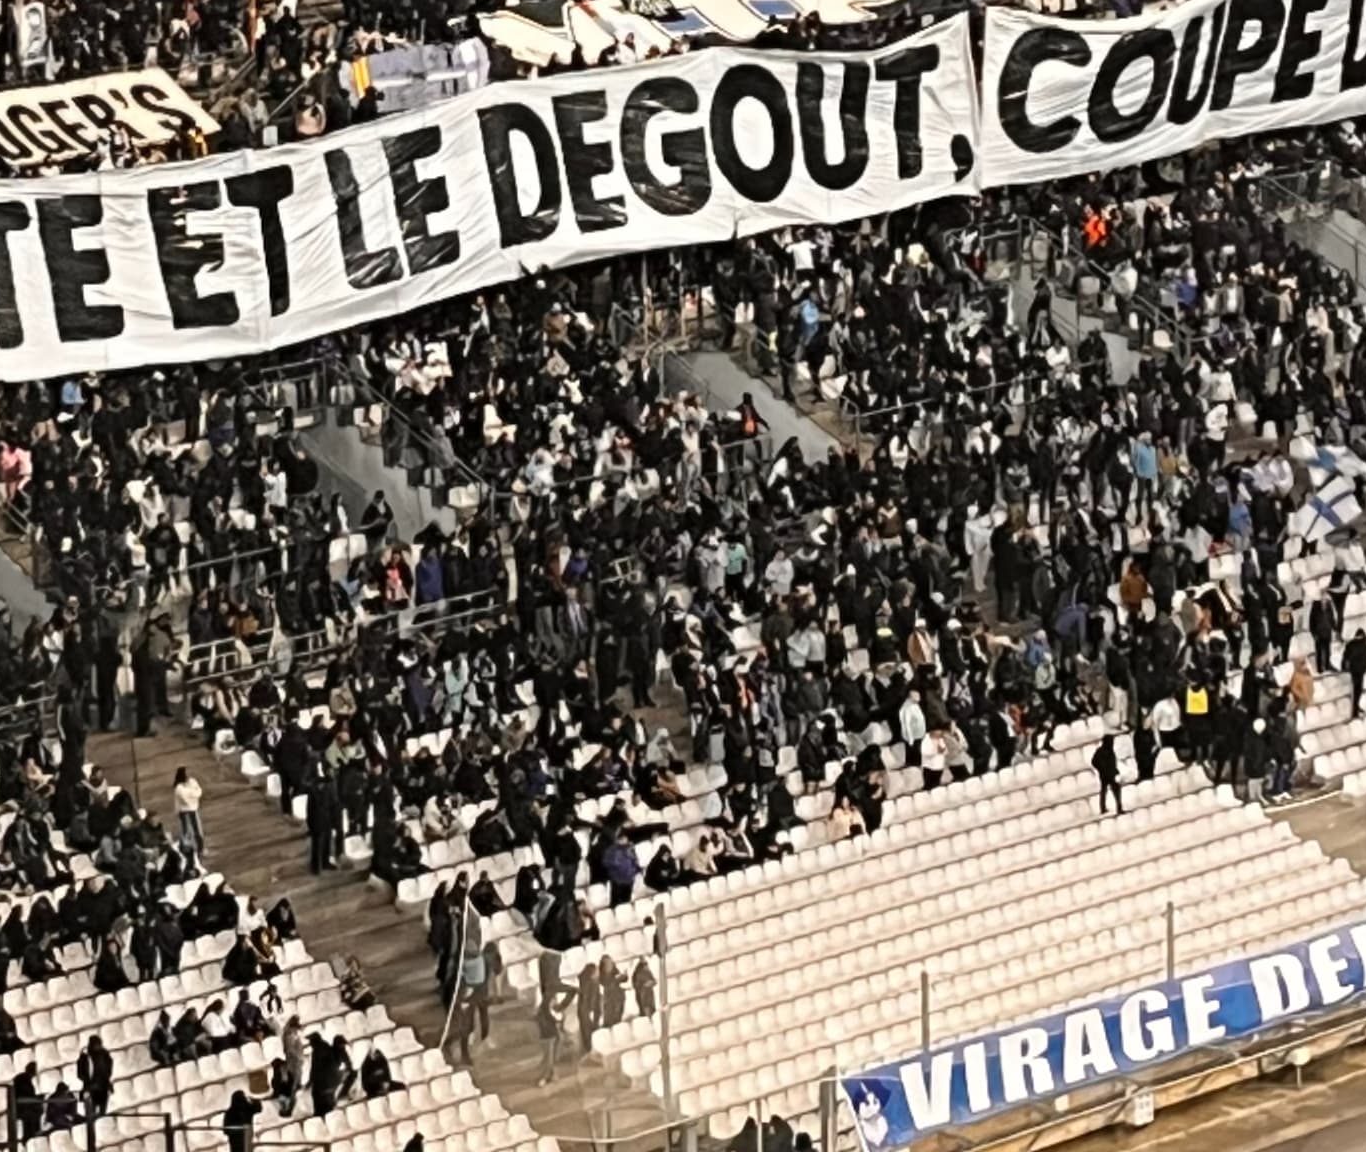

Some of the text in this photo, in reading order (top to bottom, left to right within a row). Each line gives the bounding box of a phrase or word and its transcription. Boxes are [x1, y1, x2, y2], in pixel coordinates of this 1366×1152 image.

[147, 165, 295, 331] ET
[326, 127, 460, 290] LE
[477, 46, 974, 249] DEGOUT,
[899, 974, 1226, 1131] VIRAGE
